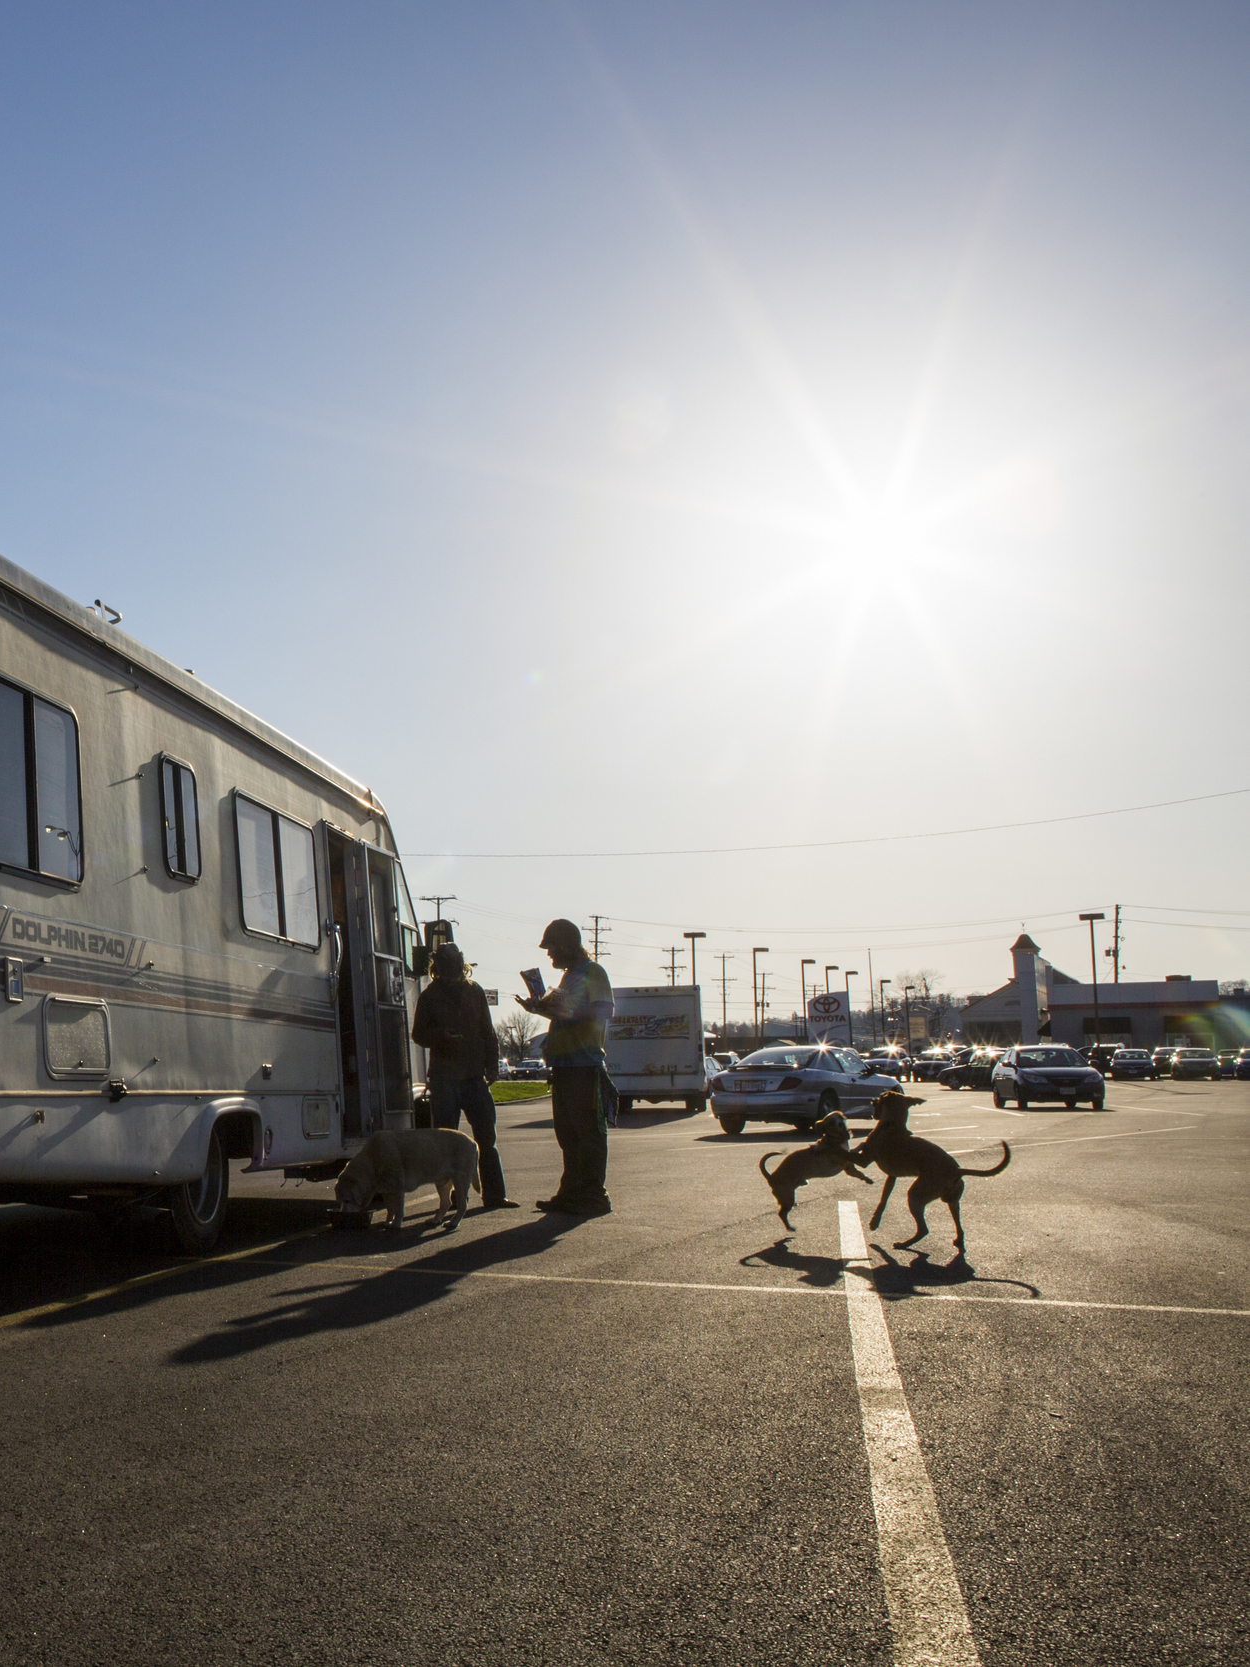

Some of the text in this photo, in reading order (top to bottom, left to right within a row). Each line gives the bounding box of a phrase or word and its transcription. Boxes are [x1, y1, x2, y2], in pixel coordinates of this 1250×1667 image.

[12, 917, 125, 960] DOLPHIN 2740
[809, 1015, 846, 1023] TOYOTA
